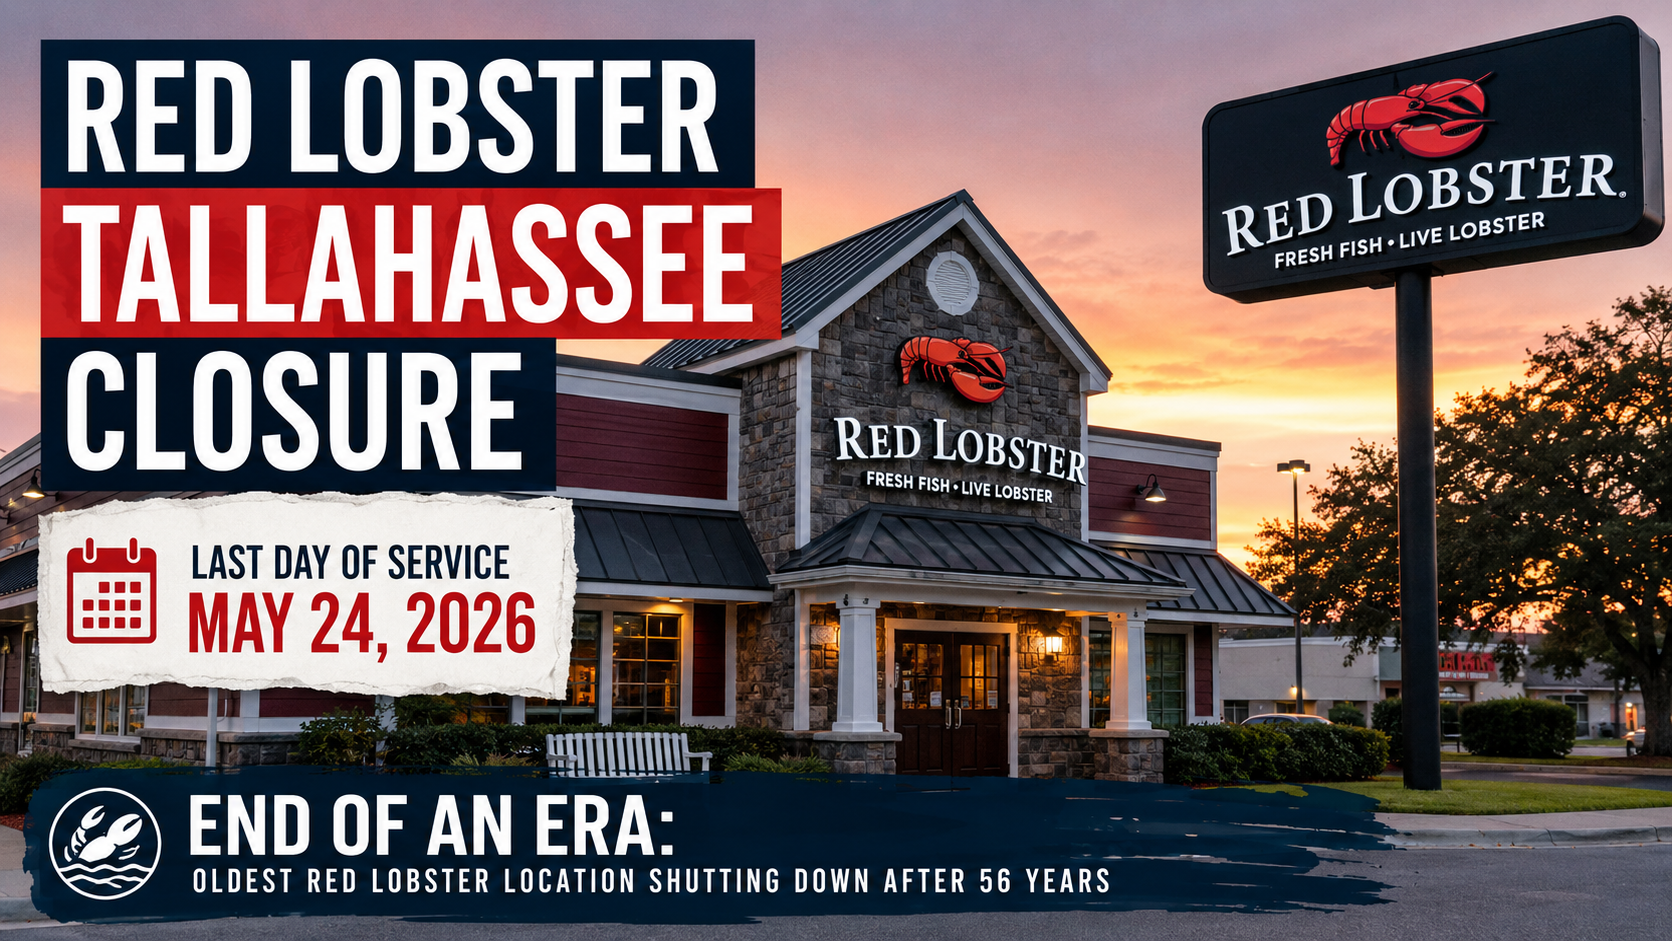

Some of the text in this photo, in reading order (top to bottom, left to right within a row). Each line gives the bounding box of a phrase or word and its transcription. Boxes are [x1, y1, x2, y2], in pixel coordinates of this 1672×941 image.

[1222, 193, 1333, 257] RED
[1274, 211, 1545, 269] FRESH FISH LIVE LOBSTER
[833, 417, 1087, 485] RED LOBSTER
[866, 471, 1053, 503] FRESH FISH LIVE LOBSTER
